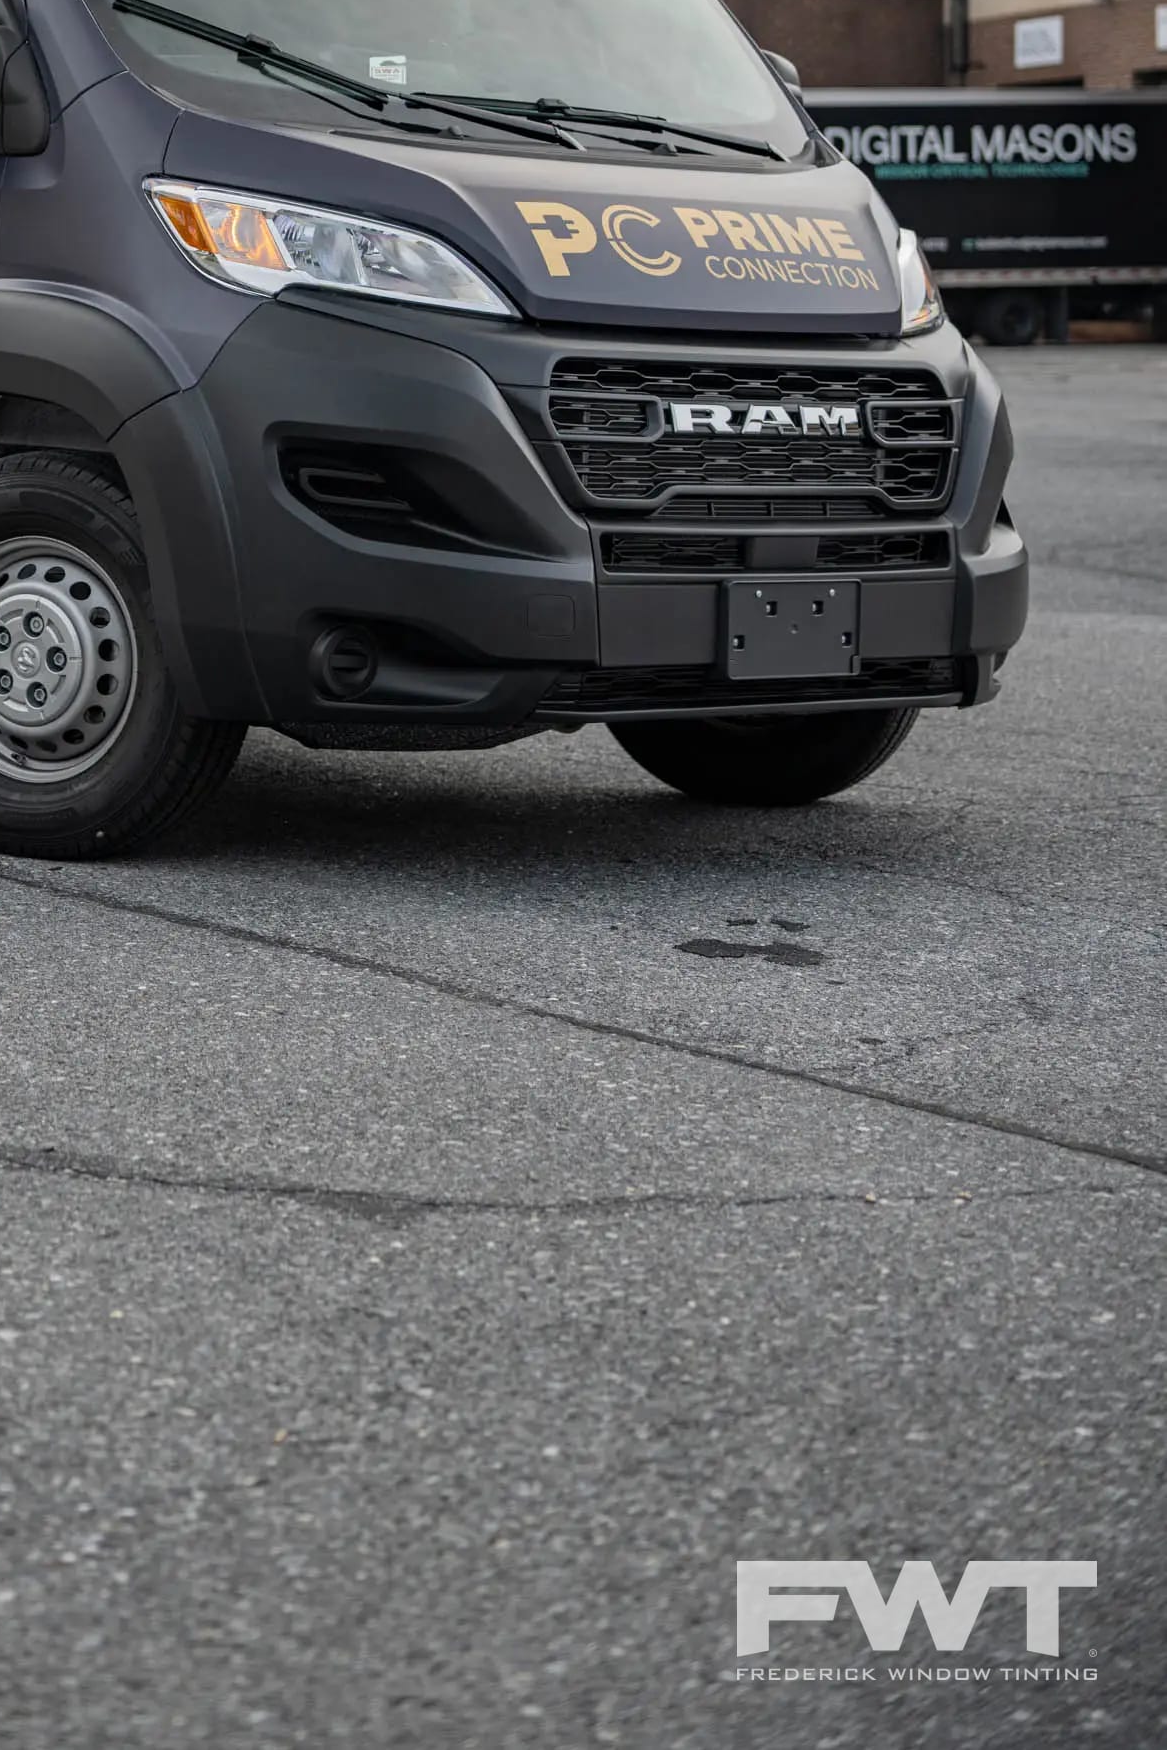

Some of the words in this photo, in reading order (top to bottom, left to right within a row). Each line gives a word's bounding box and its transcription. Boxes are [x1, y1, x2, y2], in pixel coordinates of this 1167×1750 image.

[823, 125, 968, 164] DIGITAL
[970, 123, 1138, 164] MASONS
[673, 207, 866, 262] PRIME
[705, 255, 880, 291] CONNECTION
[668, 401, 859, 437] RAM
